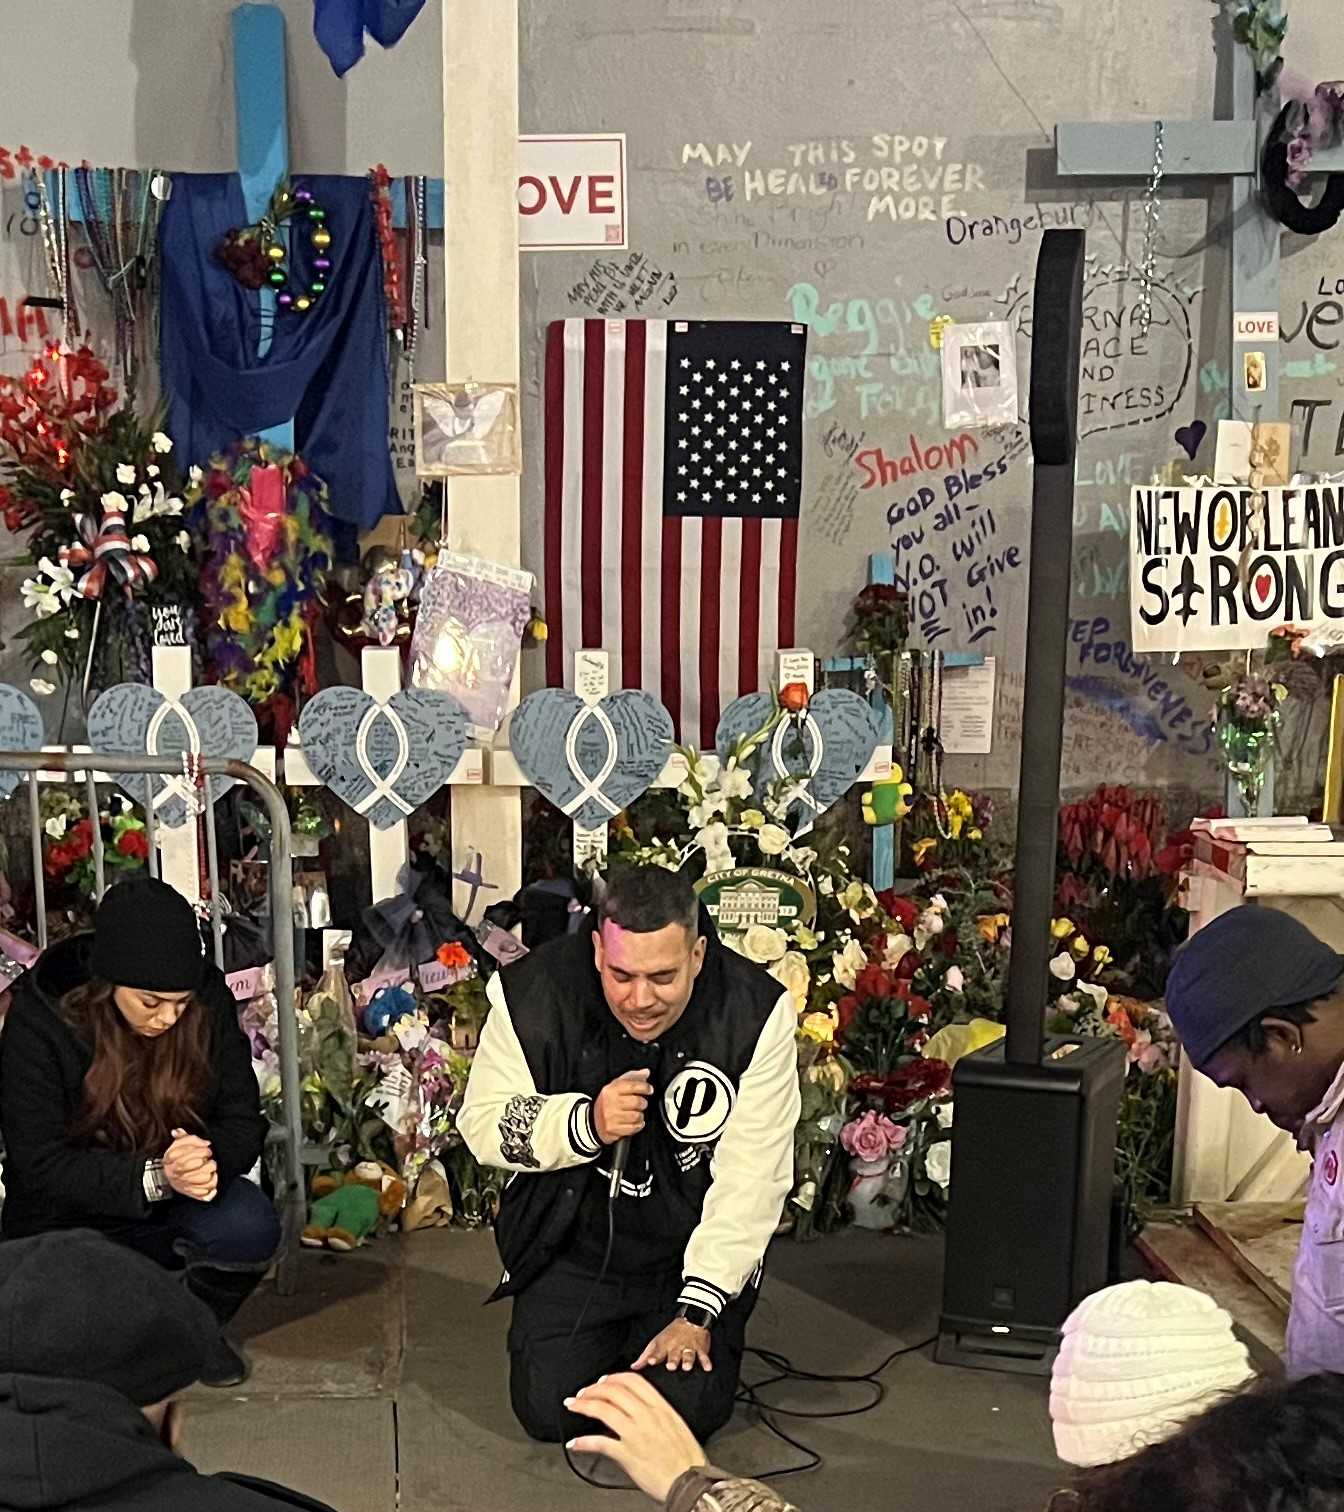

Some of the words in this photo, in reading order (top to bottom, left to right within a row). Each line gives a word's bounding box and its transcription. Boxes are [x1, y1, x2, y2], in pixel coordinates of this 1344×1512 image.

[681, 140, 753, 167] MAY
[788, 140, 858, 167] THIS
[871, 134, 948, 162] SPOT
[844, 162, 986, 192] FOREVER
[1238, 321, 1276, 335] LOVE
[854, 432, 980, 490] Shalom
[885, 486, 936, 527] GOD
[890, 526, 926, 566] you
[966, 544, 1023, 589] Give
[706, 870, 732, 884] CITY
[733, 867, 748, 878] OF
[750, 867, 796, 886] GRETNA
